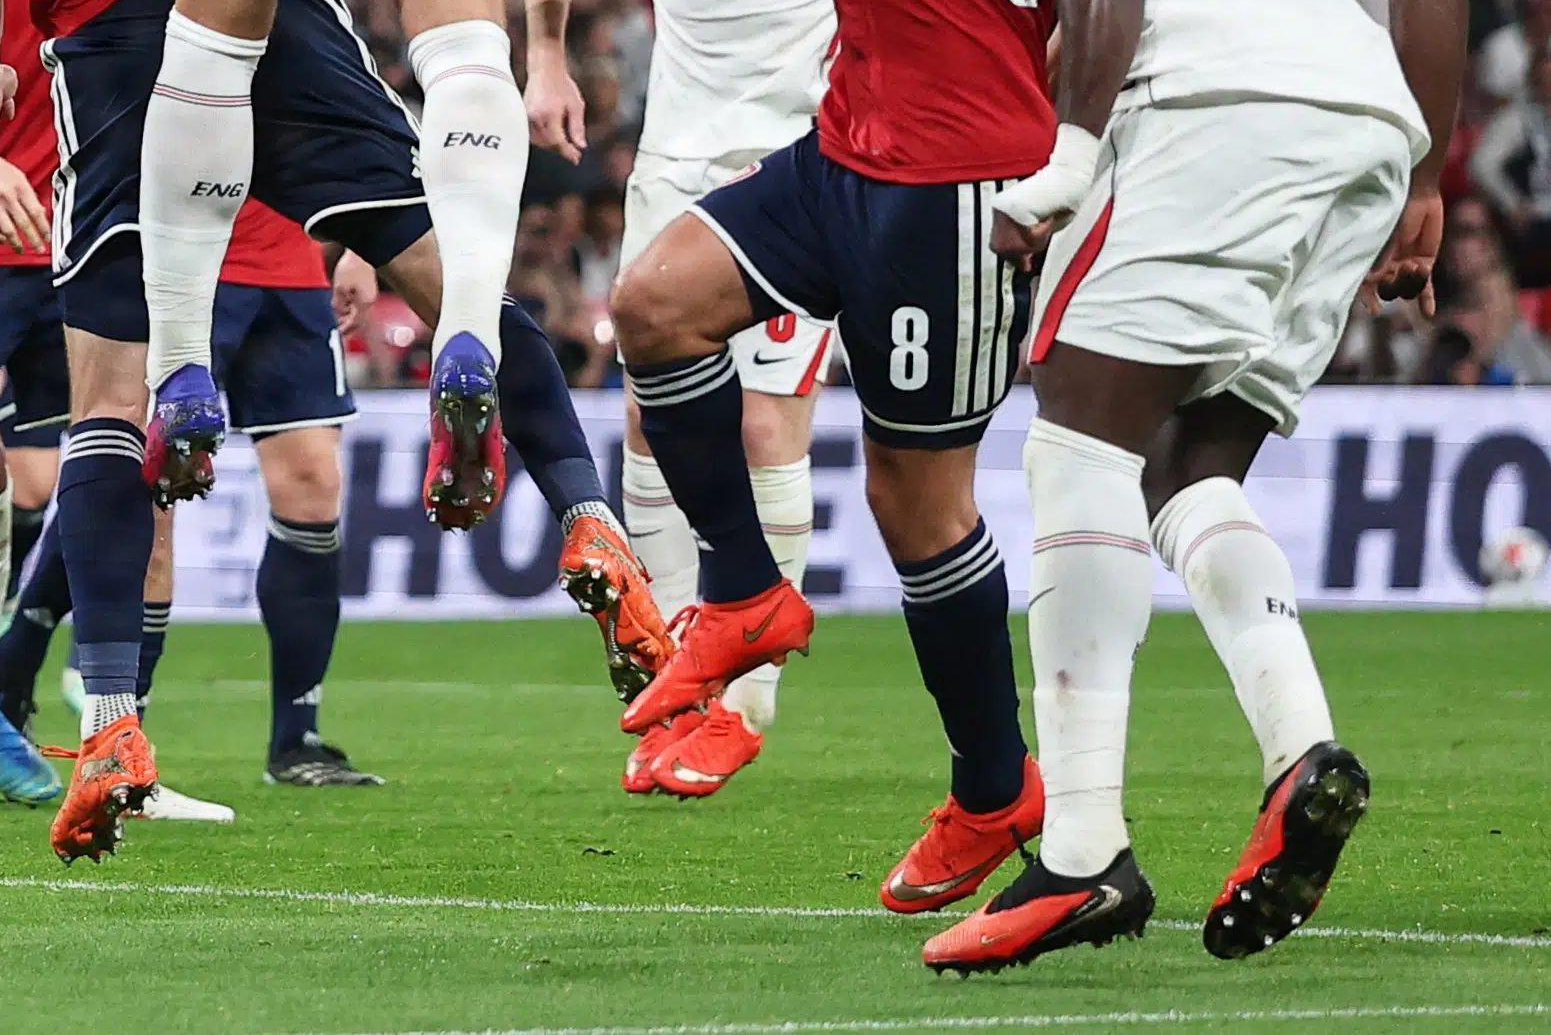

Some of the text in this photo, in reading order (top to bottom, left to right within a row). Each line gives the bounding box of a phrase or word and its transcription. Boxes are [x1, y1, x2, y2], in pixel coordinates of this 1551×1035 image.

[442, 132, 502, 150] ENG
[191, 181, 245, 197] ENG
[889, 306, 929, 391] 8
